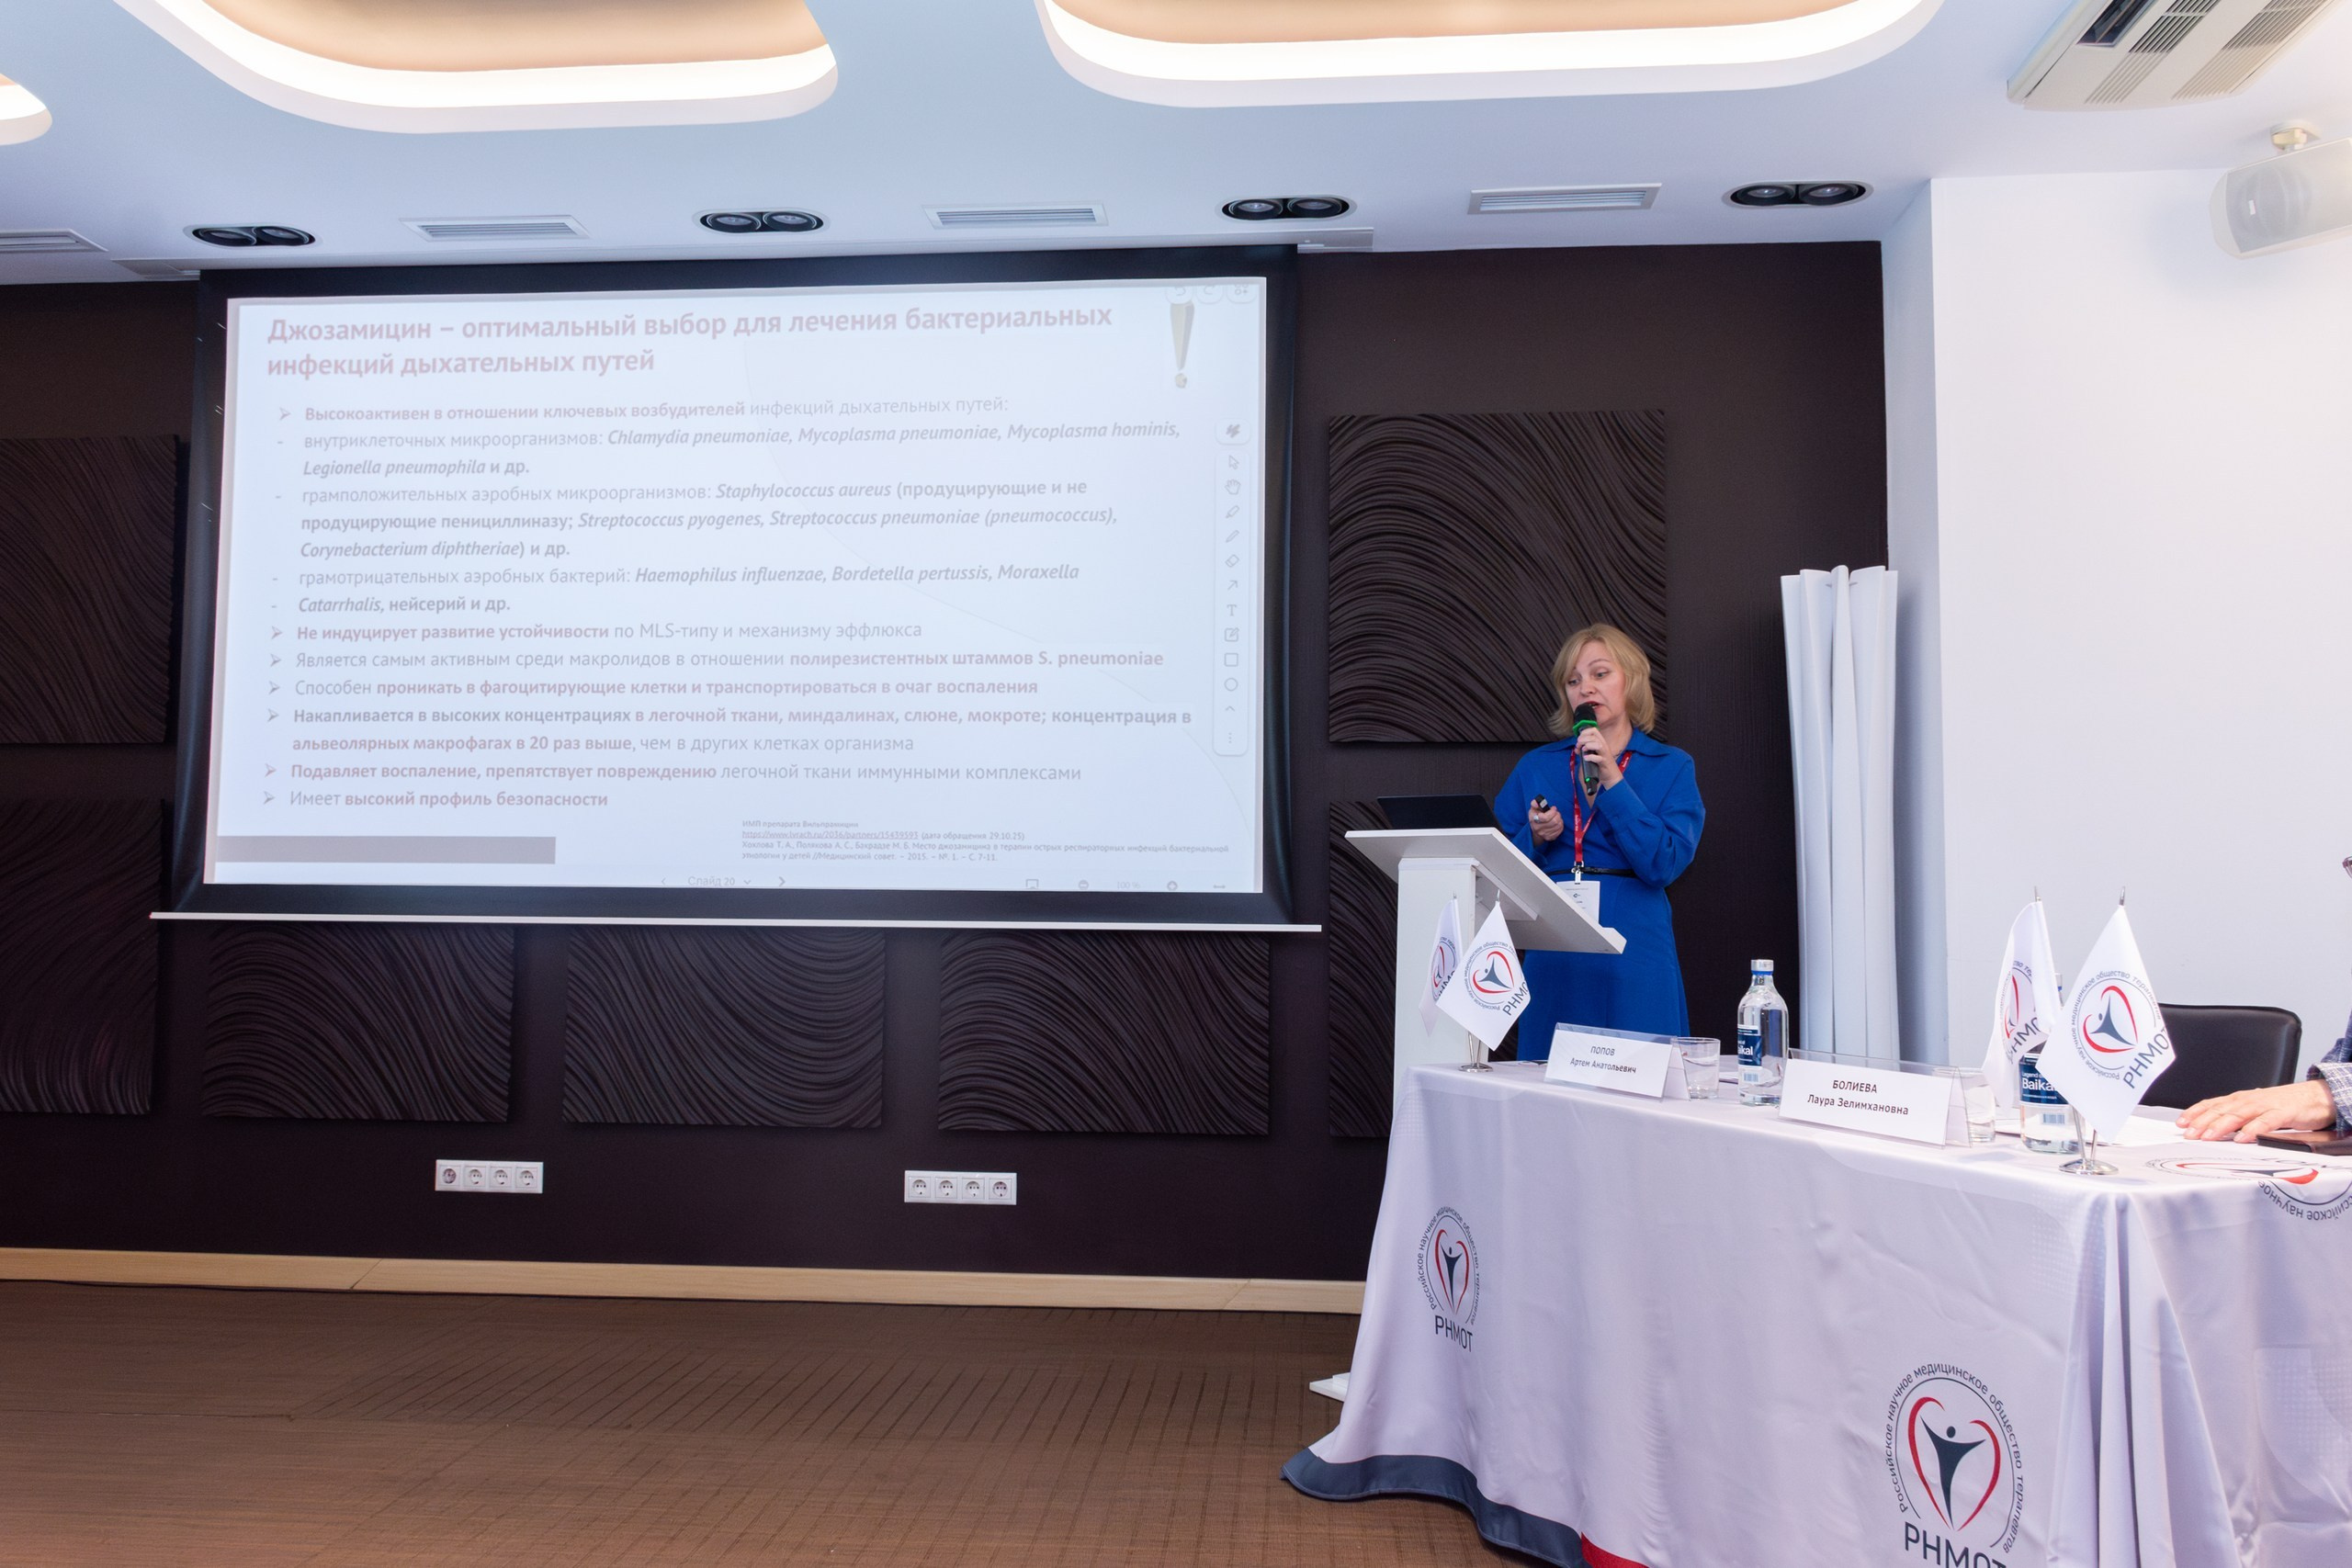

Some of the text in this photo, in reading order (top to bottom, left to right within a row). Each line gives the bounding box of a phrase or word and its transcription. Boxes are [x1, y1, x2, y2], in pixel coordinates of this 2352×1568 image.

[266, 303, 1113, 344] Джозамицин оптимальный выбор для лечения бактериальных
[266, 348, 654, 381] инфекций дыхательных путей
[304, 396, 1008, 422] Высокоактивен отношении ключевых возбудителей инфекций дыхательных путей:
[303, 420, 1180, 452] внутриклеточных микроорганизмов: Chlamydia pneumoniae, Mycoplasma pneumoniae, Mycoplasma hominis,
[302, 458, 530, 479] Legionella pneumophila др.
[302, 479, 1087, 506] грамположительных аэробных микроорганизмов: Staphylococcus aureus (продуцирующие не
[300, 507, 1116, 534] продуцирующие пенициллиназу; Streptococcus pyogenes, Streptococcus pneumoniae (pneumococcus),
[300, 540, 571, 560] Corynebacterium diphtheriae) др.
[299, 563, 1080, 588] грамотрицательных аэробных бактерий: Haemophilus influenzae, Bordetella pertussis, Moraxella
[298, 595, 511, 615] Catarrhalis, нейсерий др.
[297, 622, 922, 642] Не индуцирует развитие устойчивости по MLS-типу механизму эффлюкса
[295, 650, 1163, 670] Является самым активным среди макролидов отношении полирезистентных штаммов S. pneumoniae
[295, 679, 1037, 697] Способен проникать фагоцитирующие клетки транспортироваться очаг воспаления
[293, 706, 1177, 726] Накапливается высоких концентрациях легочной ткани, миндалинах, слюне, мокроте; концентрация
[291, 735, 913, 754] альвеолярных макрофагах 20 раз выше, чем других клетках организма
[290, 763, 1081, 783] Подавляет воспаление, препятствует повреждению легочной ткани иммунными комплексами
[289, 790, 608, 809] Имеет высокий профиль безопасности
[687, 875, 735, 886] Слайд 20
[2096, 970, 2131, 981] общество
[1589, 1045, 1615, 1056] ПОПОВ
[1569, 1057, 1637, 1074] Артем Анатольевич
[1832, 1079, 1878, 1094] БОЛИЕВА
[2022, 1077, 2055, 1091] Baika
[1807, 1094, 1909, 1115] Лаура Зелимхановна
[1419, 1214, 1438, 1252] научное
[1417, 1252, 1438, 1311] Российское
[1435, 1314, 1474, 1353] РНМОТ
[1885, 1362, 2025, 1554] Российское научное медицинское общество терапевтов
